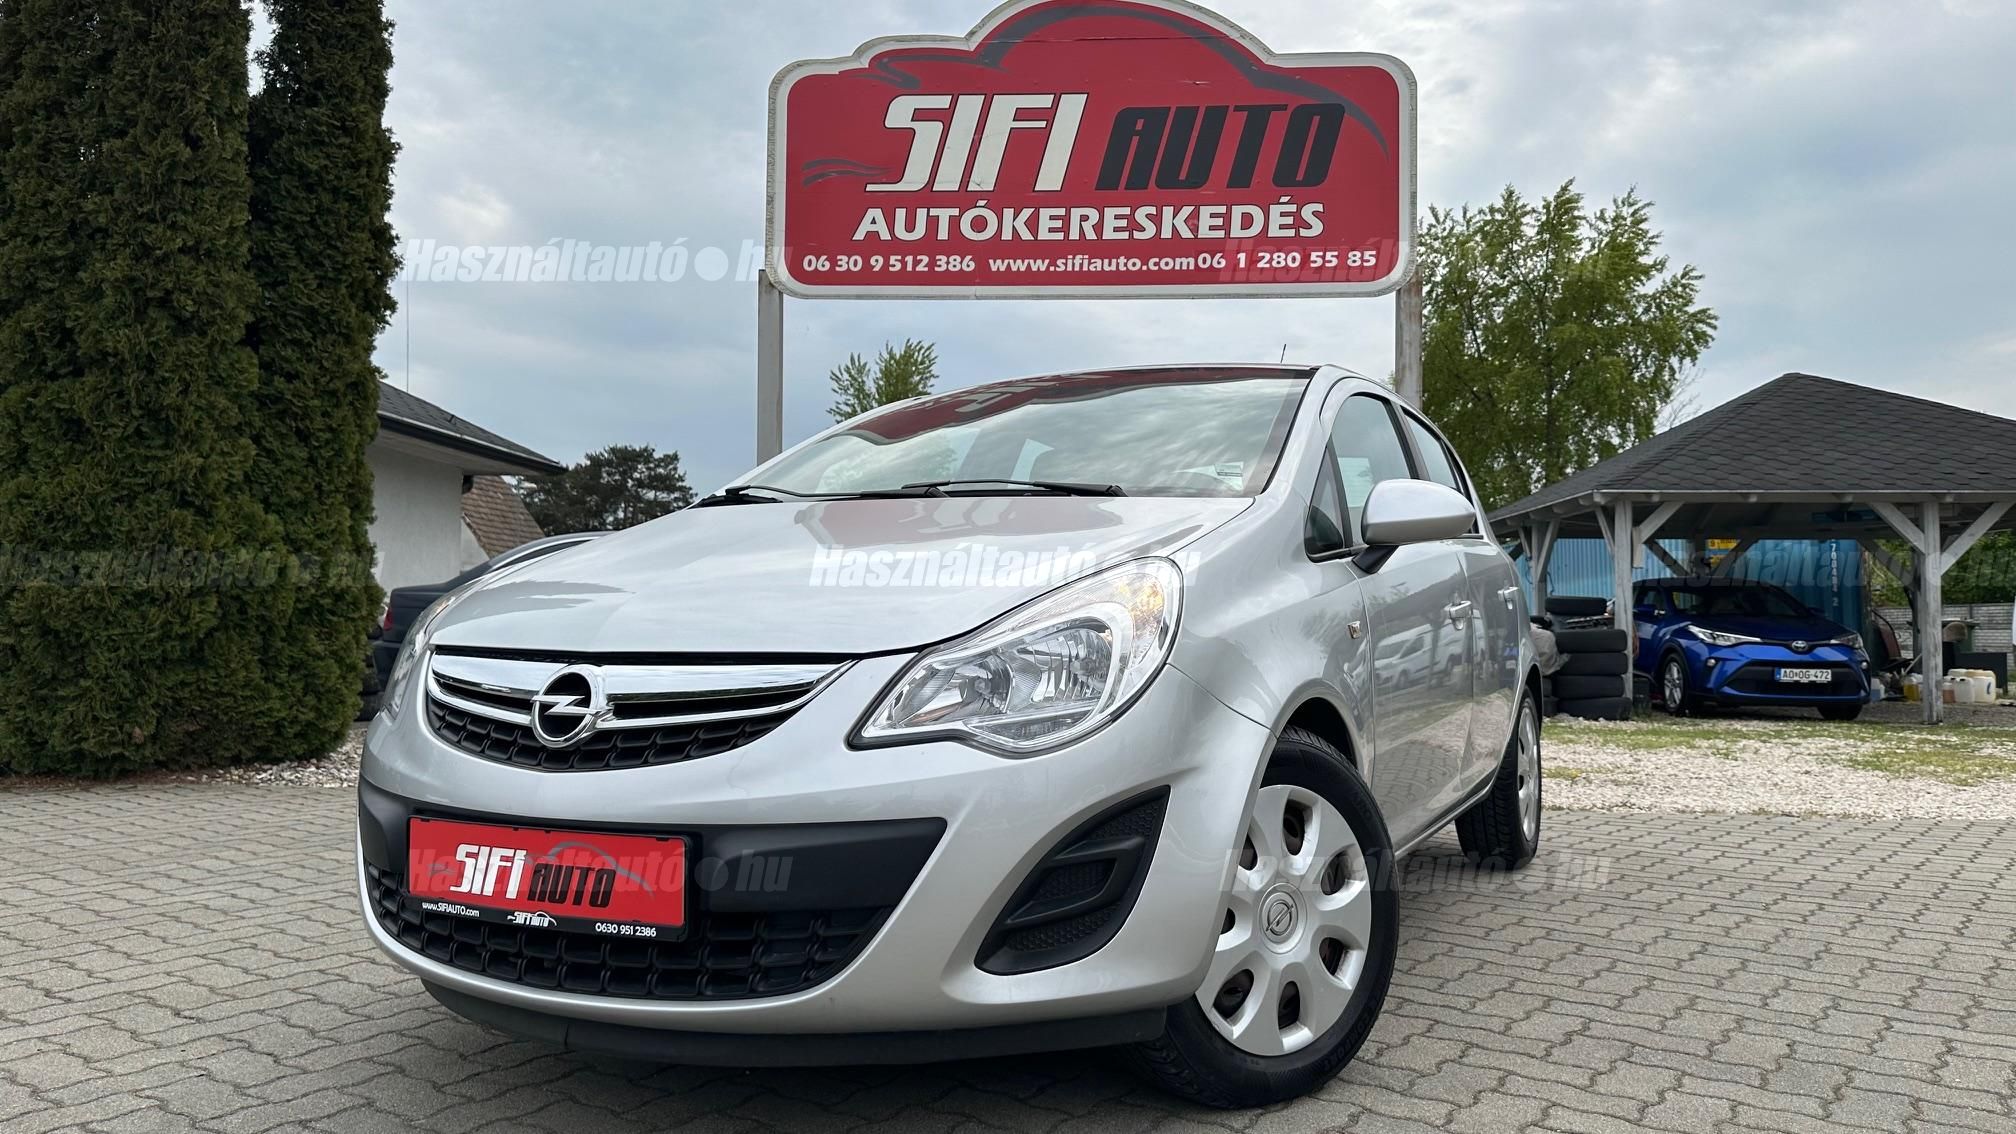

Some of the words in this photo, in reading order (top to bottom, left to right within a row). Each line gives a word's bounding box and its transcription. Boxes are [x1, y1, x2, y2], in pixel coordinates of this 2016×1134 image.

[865, 93, 1087, 192] SIFI
[1096, 103, 1346, 191] AUTO
[852, 196, 1325, 241] AUTÓKERESKEDÉS
[803, 255, 831, 272] 06
[835, 255, 863, 272] 30
[934, 255, 976, 272] 386
[989, 254, 1194, 272] www.sifiauto.com
[1197, 253, 1226, 269] 06
[1237, 252, 1246, 268] 1
[1256, 252, 1301, 268] 280
[1309, 251, 1339, 267] 55
[1346, 250, 1377, 267] 85
[449, 843, 527, 900] SIFI
[527, 862, 617, 908] AUTO
[421, 902, 480, 918] www.SIFIAUTO.com
[595, 922, 619, 934] 0630
[619, 924, 634, 935] 951
[634, 926, 657, 938] 2386
